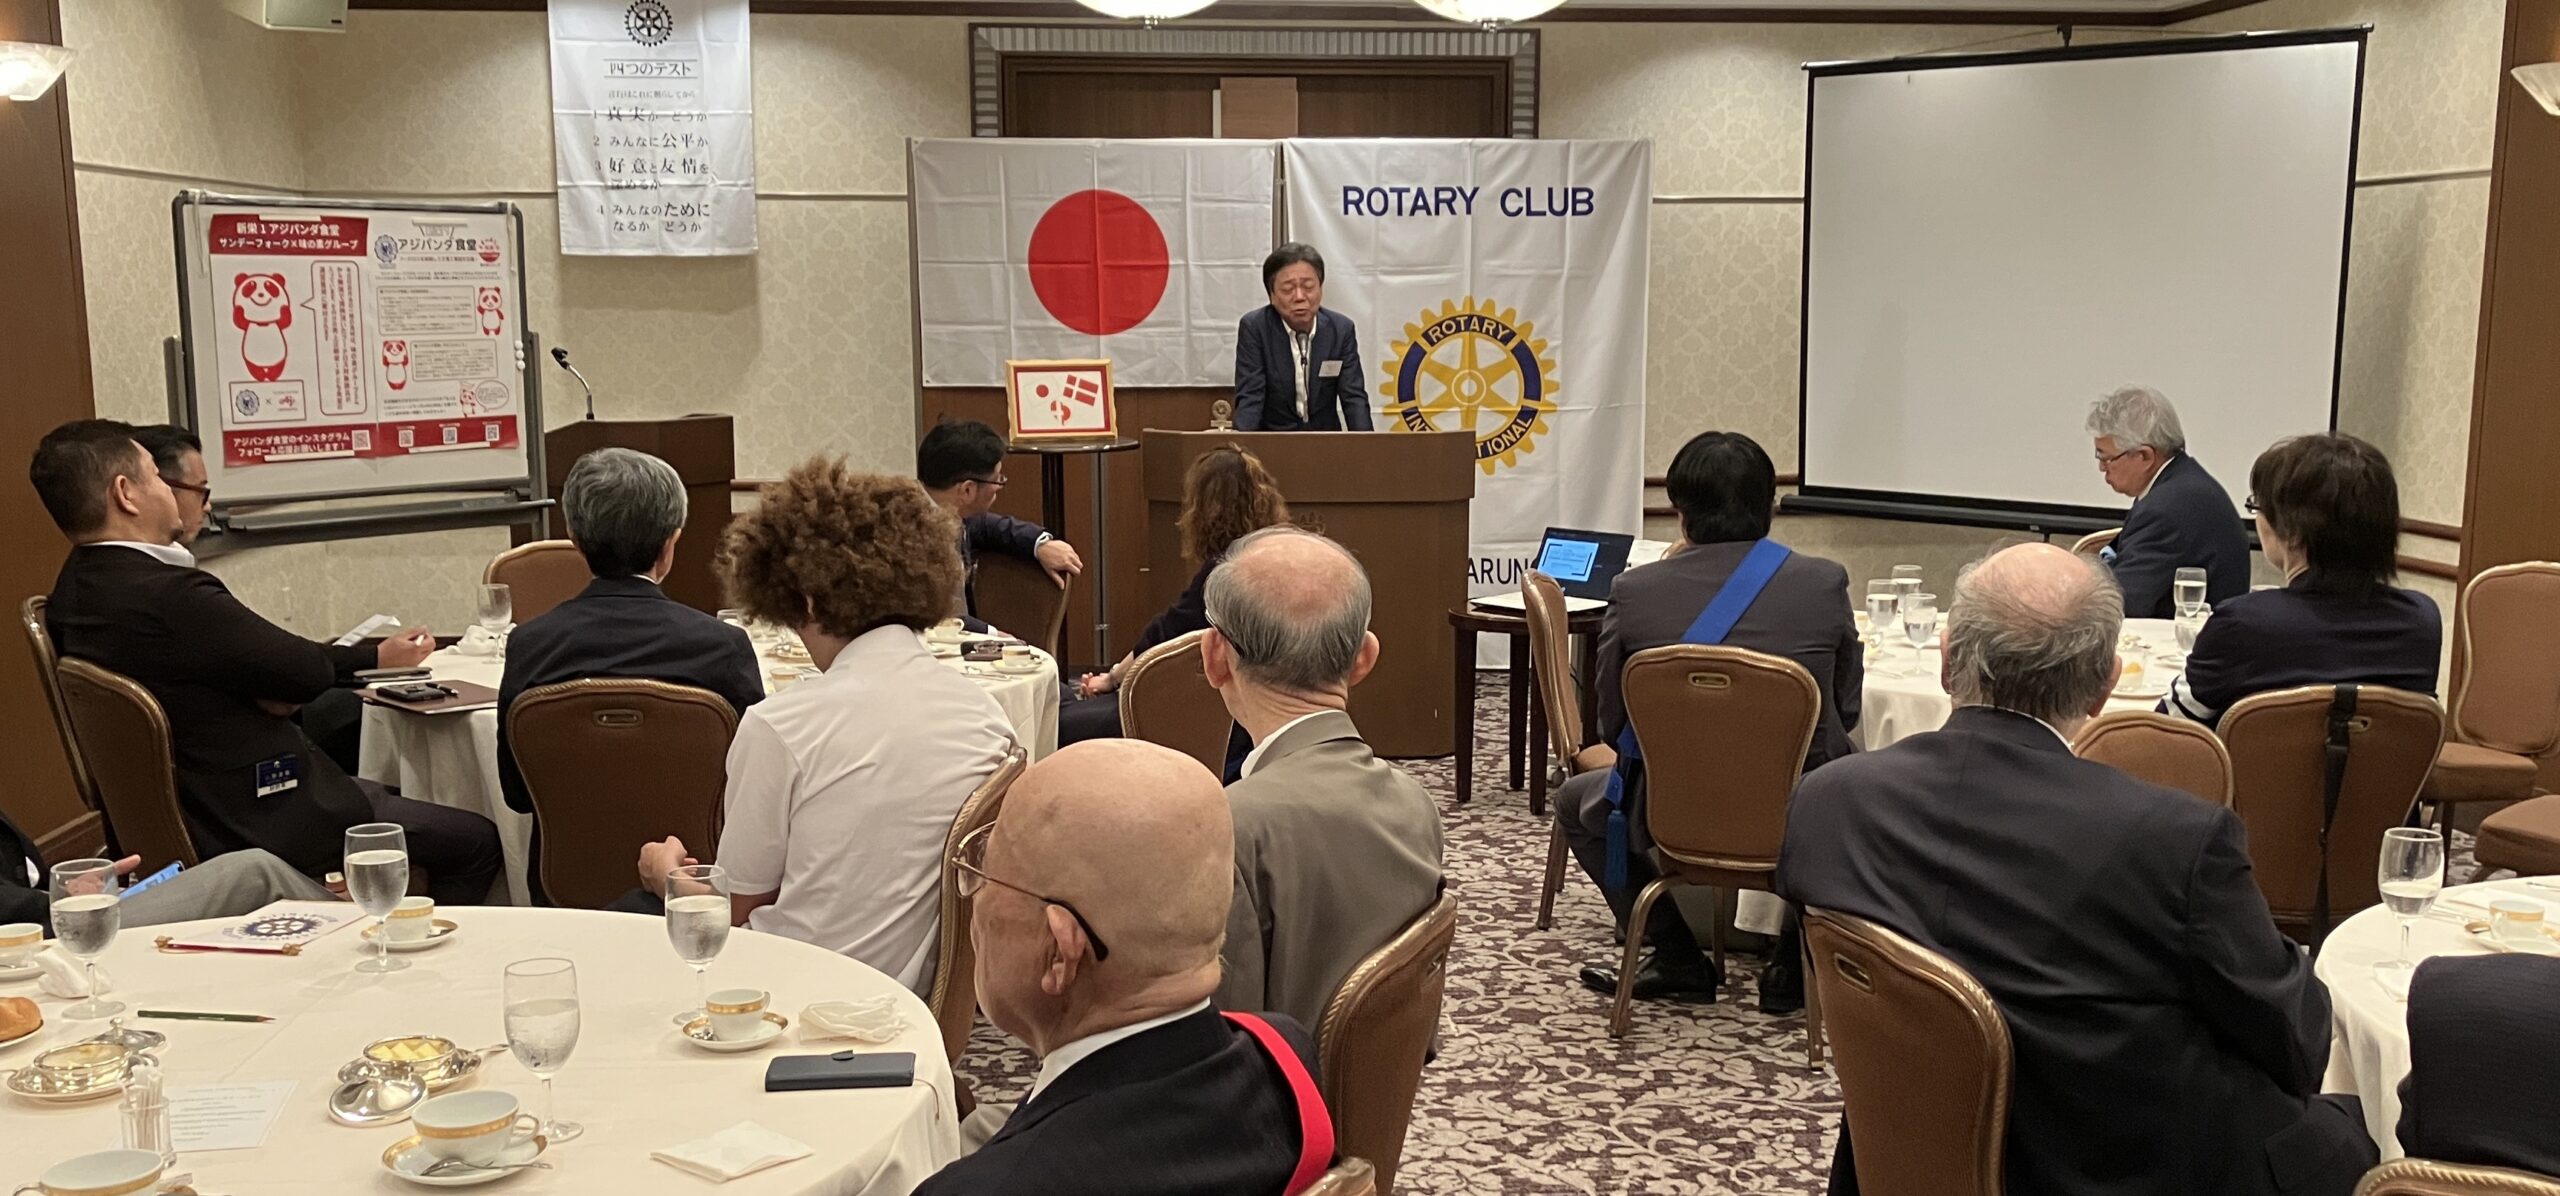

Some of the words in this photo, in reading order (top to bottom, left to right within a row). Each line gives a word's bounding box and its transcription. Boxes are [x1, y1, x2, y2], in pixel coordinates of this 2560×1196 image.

[610, 62, 691, 76] 四つのテスト
[593, 135, 600, 146] 2
[609, 133, 708, 149] みんなに公平か
[1343, 186, 1480, 216] ROTARY
[1500, 187, 1595, 217] CLUB
[612, 202, 710, 217] みんなのために
[613, 221, 650, 232] なるか
[665, 221, 702, 233] どうか
[398, 238, 477, 251] アジパンダ食堂
[1427, 315, 1510, 343] ROTARY
[1467, 557, 1536, 585] ARUN
